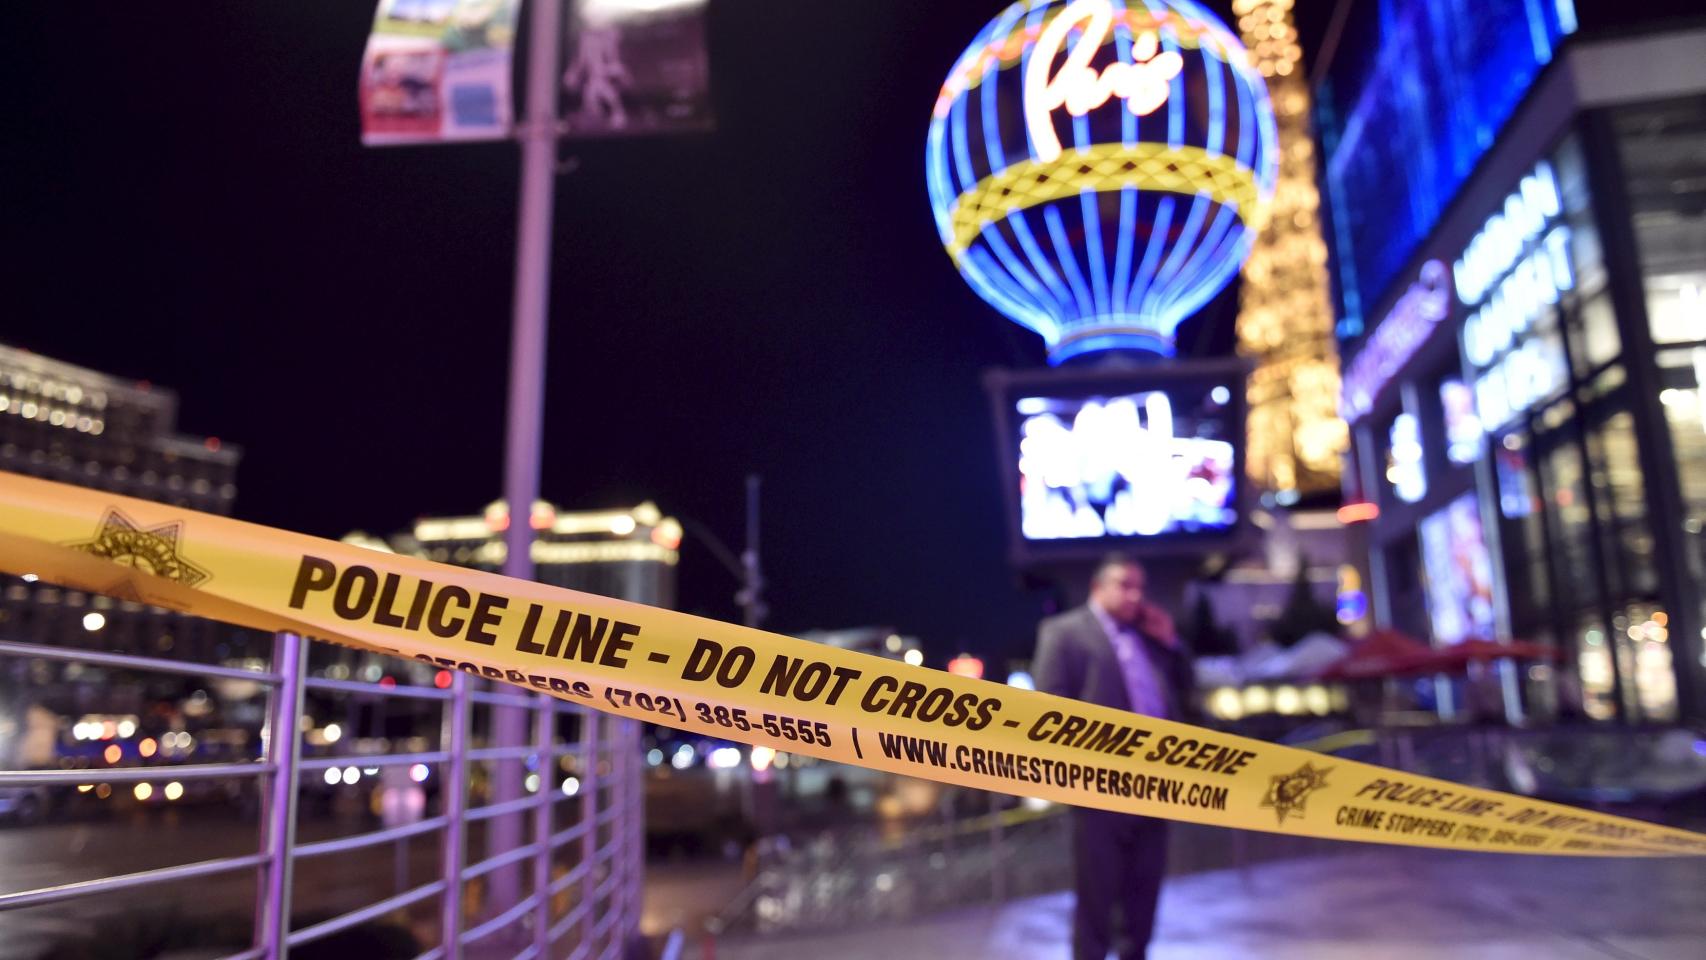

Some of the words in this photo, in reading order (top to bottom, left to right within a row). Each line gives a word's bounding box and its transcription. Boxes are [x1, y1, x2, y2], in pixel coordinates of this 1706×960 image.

[289, 554, 509, 647] POLICE
[515, 603, 642, 669] LINE
[647, 651, 671, 664] -
[681, 638, 756, 688] DO
[760, 654, 862, 706] NOT
[860, 675, 1002, 731] CROSS
[1003, 719, 1020, 728] -
[1027, 710, 1152, 758] CRIME
[1144, 735, 1257, 775] SCENE
[414, 654, 594, 698] OPPERS
[605, 687, 687, 722] (702)
[695, 702, 832, 748] 385-5555
[878, 732, 1229, 811] WWW.CRIMESTOPPERSOFNV.COM
[1336, 805, 1387, 830] CRIME
[1385, 813, 1456, 838] STOPPERS
[1355, 778, 1454, 808] POLICE
[1440, 795, 1504, 817] LINE
